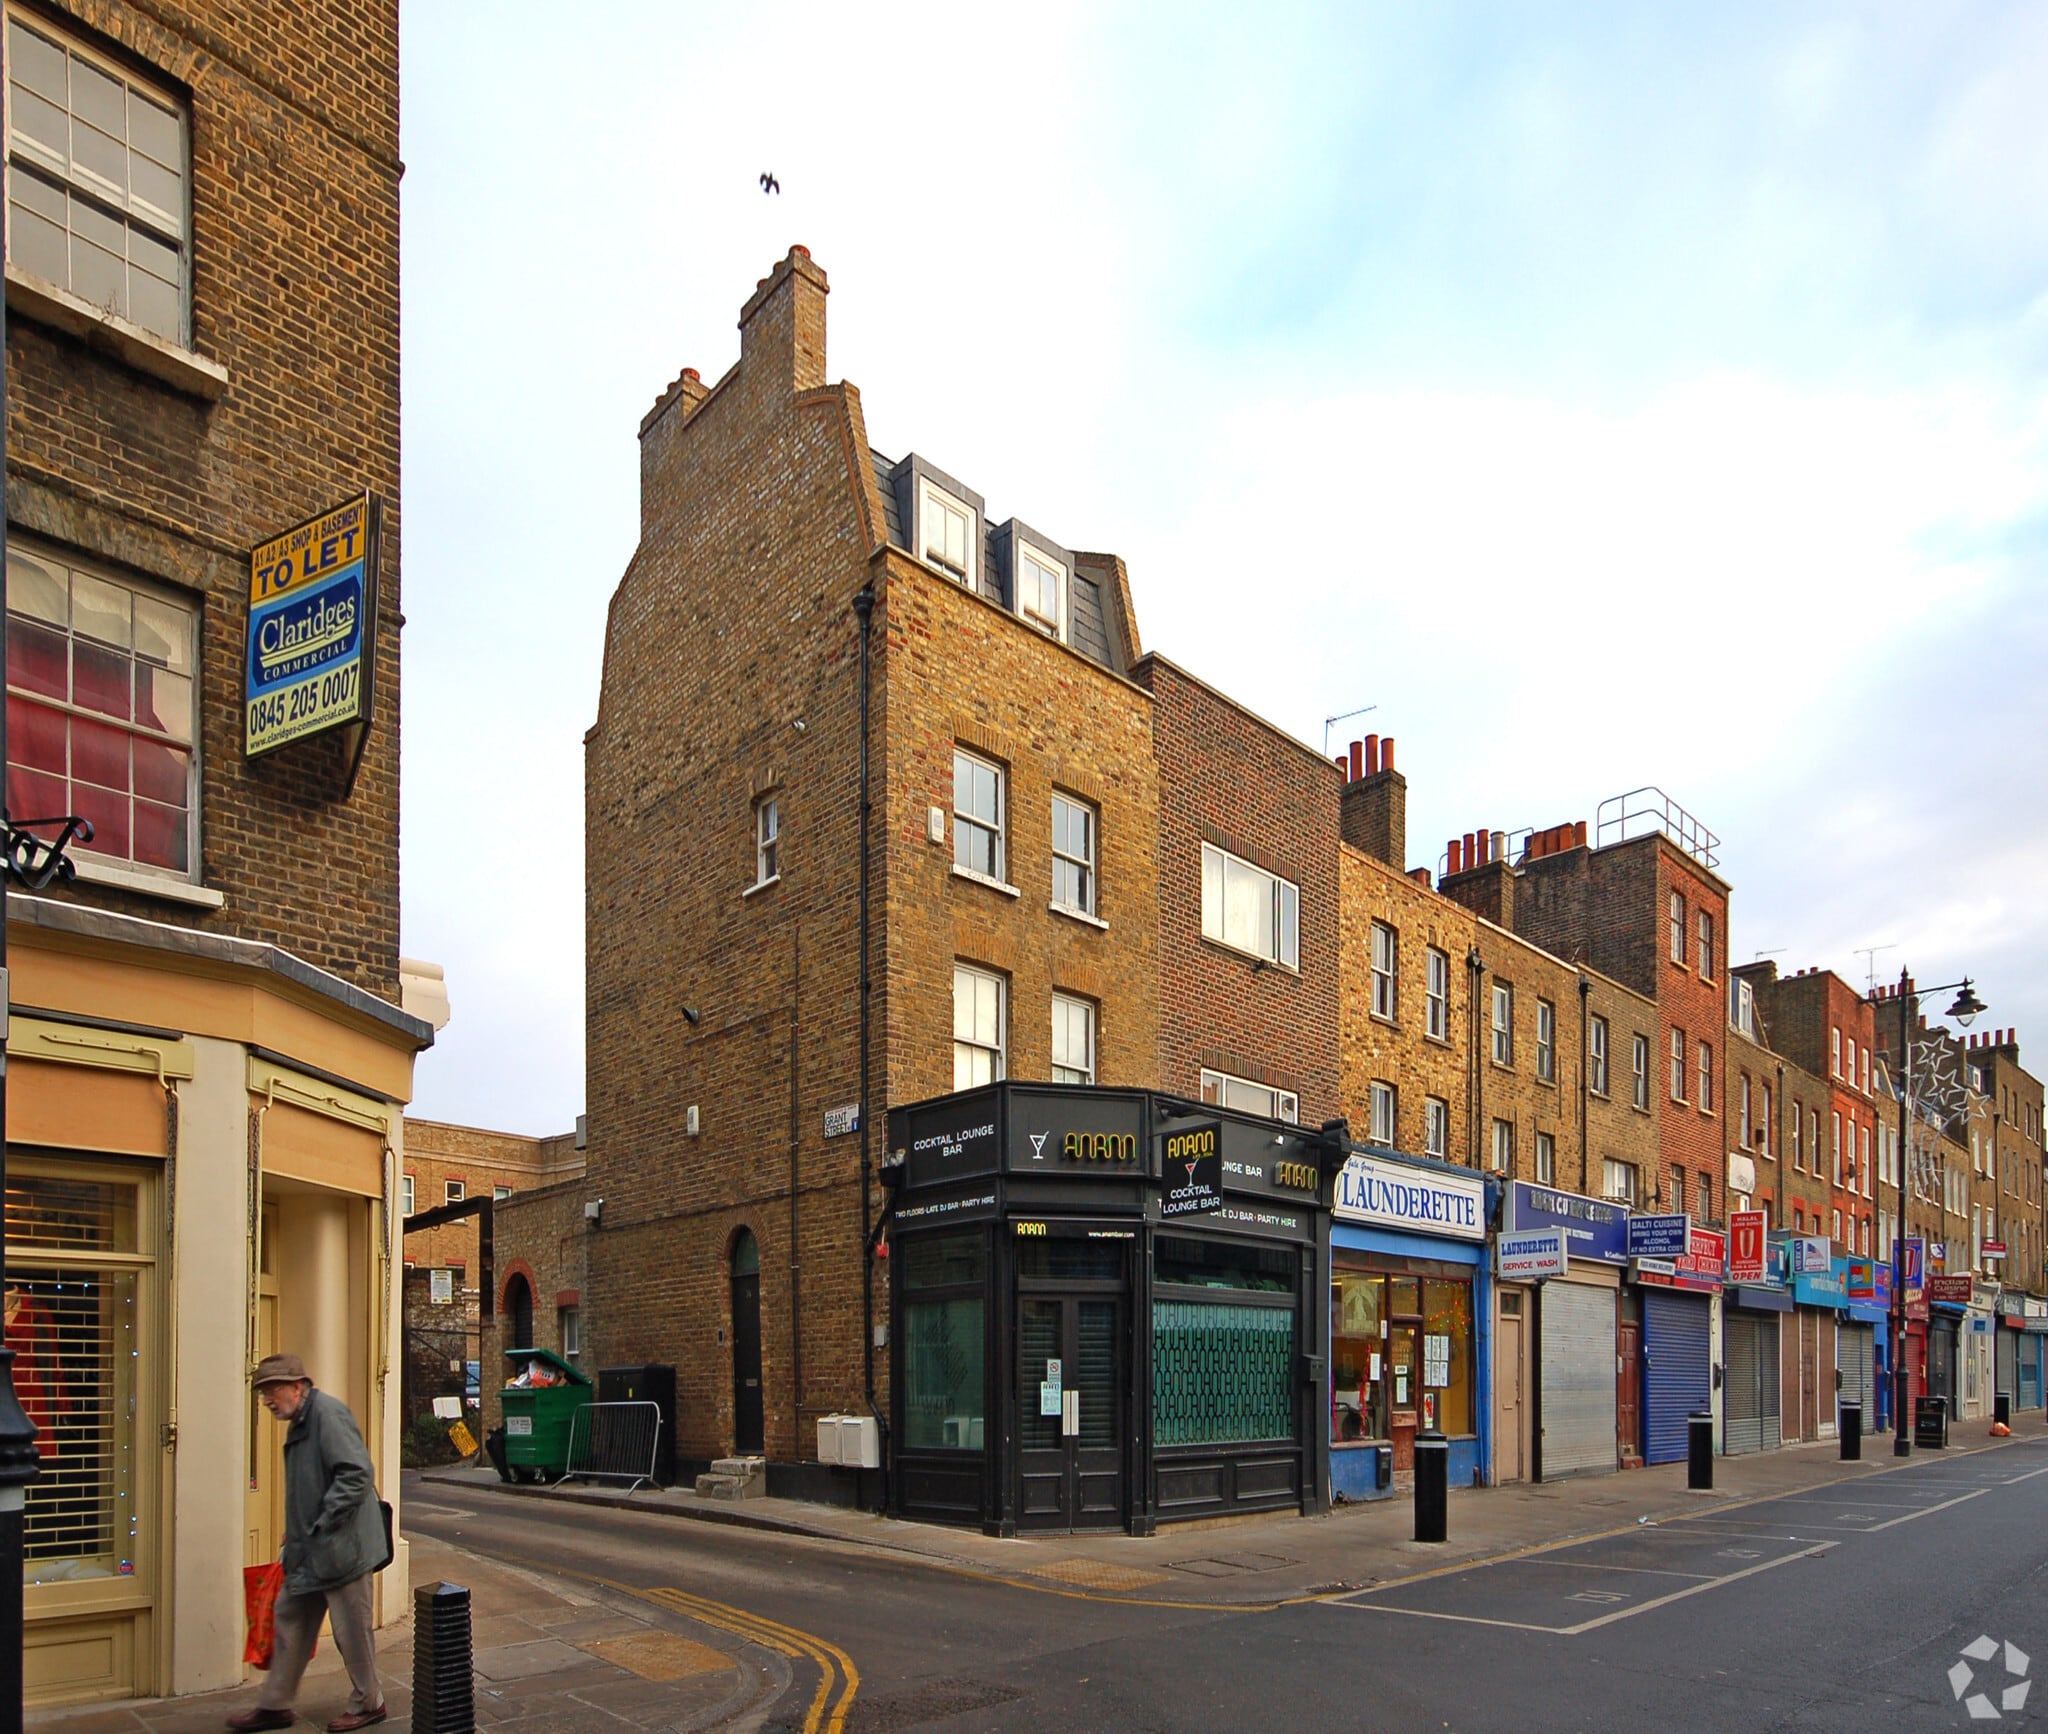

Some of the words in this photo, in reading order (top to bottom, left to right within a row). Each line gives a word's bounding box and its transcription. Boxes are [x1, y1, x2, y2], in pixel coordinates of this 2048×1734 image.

[266, 544, 276, 563] A2
[291, 528, 311, 552] SHOP
[322, 503, 364, 538] BASEMENT
[257, 558, 293, 595] TO
[303, 526, 359, 576] LET
[259, 595, 355, 655] Claridges
[264, 640, 347, 681] COMMERCIAL
[250, 694, 285, 735] 0845
[289, 682, 317, 722] 205
[323, 663, 359, 707] 0007
[825, 1112, 847, 1126] GRANT
[825, 1122, 848, 1137] STREET
[914, 1134, 954, 1150] COCKTAIL
[957, 1124, 995, 1141] LOUNGE
[943, 1144, 962, 1156] BAR
[1245, 1165, 1262, 1177] BAR
[1170, 1184, 1213, 1199] COCKTAIL
[1342, 1171, 1476, 1226] LAUNDERETTE
[948, 1201, 959, 1210] BAR
[961, 1198, 980, 1208] PARTY
[982, 1195, 995, 1204] HIRE
[1163, 1200, 1198, 1214] LOUNGE
[1201, 1196, 1220, 1208] BAR
[1228, 1209, 1238, 1220] DJ
[1239, 1211, 1254, 1222] BAR
[1257, 1213, 1280, 1225] PARTY
[1281, 1217, 1297, 1228] HIRE
[1632, 1220, 1652, 1229] BALTI
[1653, 1219, 1683, 1228] CUISINE
[1501, 1238, 1558, 1256] LAUNDERETTE
[1648, 1245, 1667, 1253] EXTRA
[1667, 1244, 1683, 1252] COST
[1503, 1260, 1533, 1271] SERVICE
[1536, 1258, 1558, 1268] WASH
[1732, 1271, 1762, 1281] OPEN
